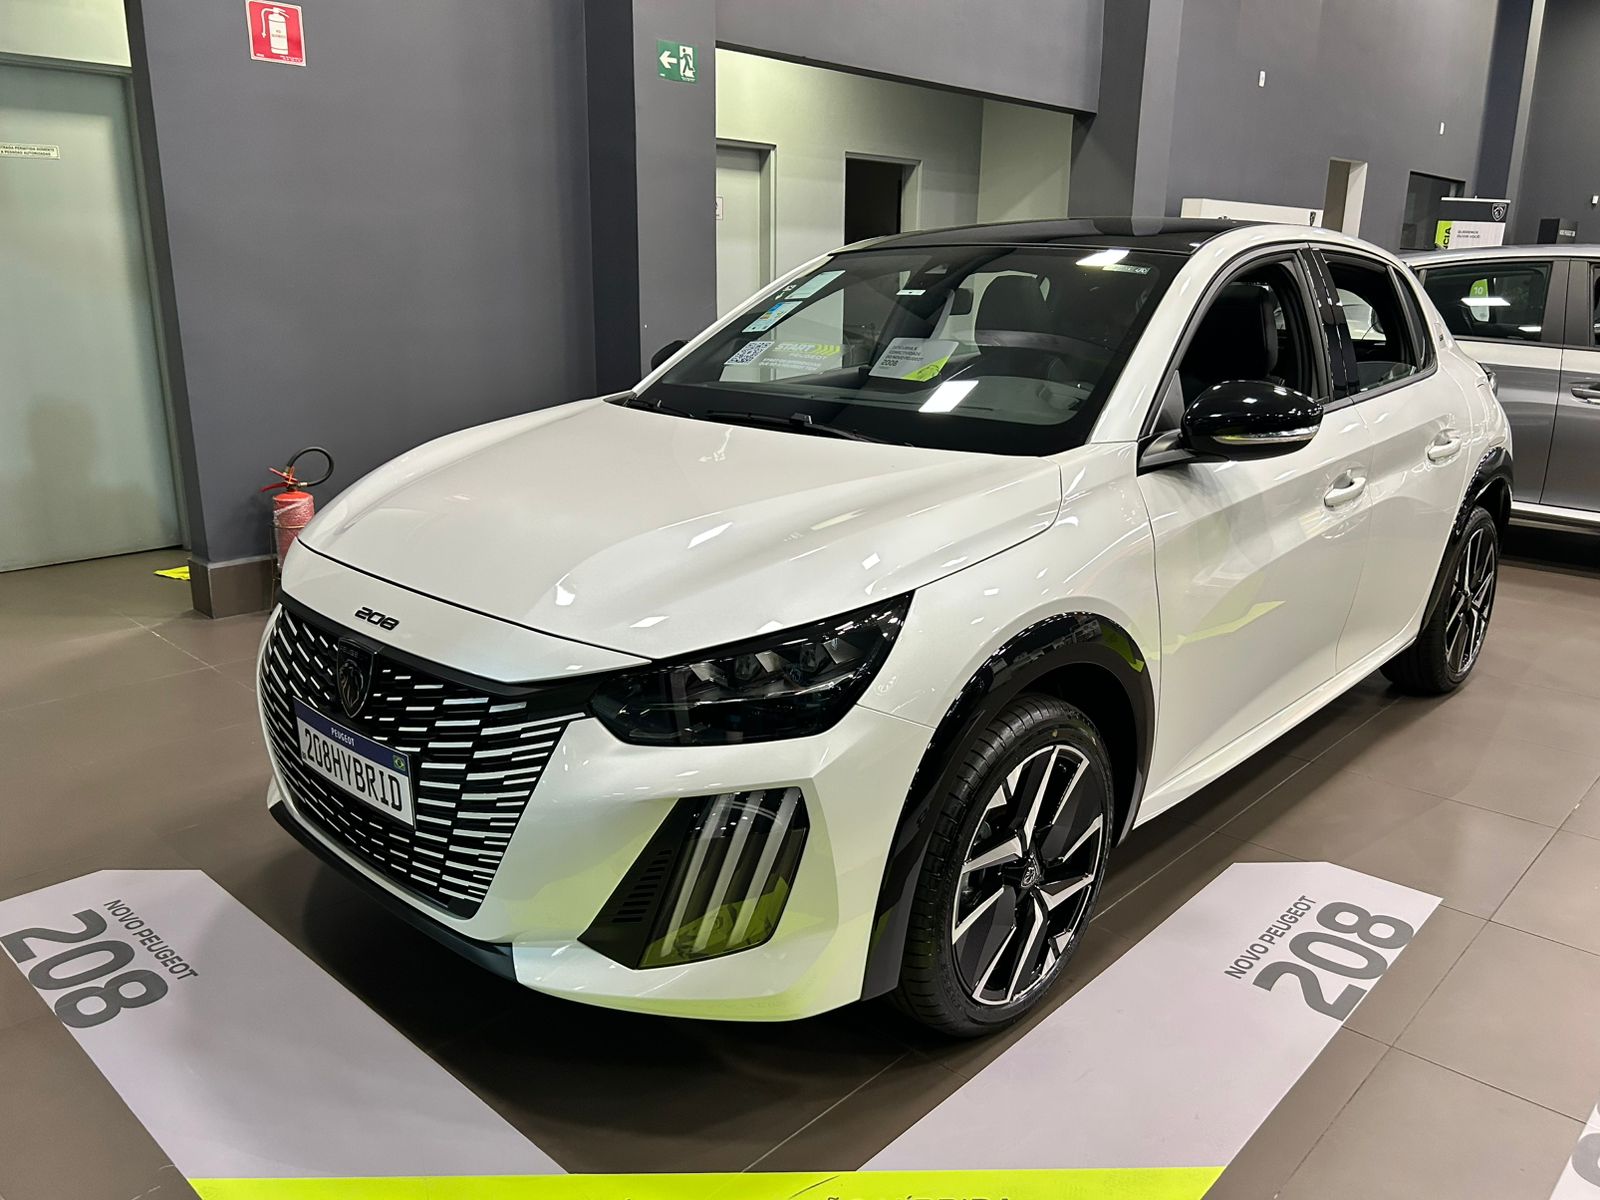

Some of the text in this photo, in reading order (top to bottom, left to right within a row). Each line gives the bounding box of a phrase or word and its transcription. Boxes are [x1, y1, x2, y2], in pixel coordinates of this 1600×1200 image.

[1473, 286, 1484, 295] 10
[355, 606, 400, 631] 208
[305, 728, 403, 812] 208HYBRID
[330, 727, 355, 747] PEUGEOT
[0, 908, 169, 1029] 208
[104, 899, 199, 980] NOVO PEUGEOT
[1224, 895, 1317, 979] NOVO PEUGEOT
[1252, 901, 1415, 1022] 208
